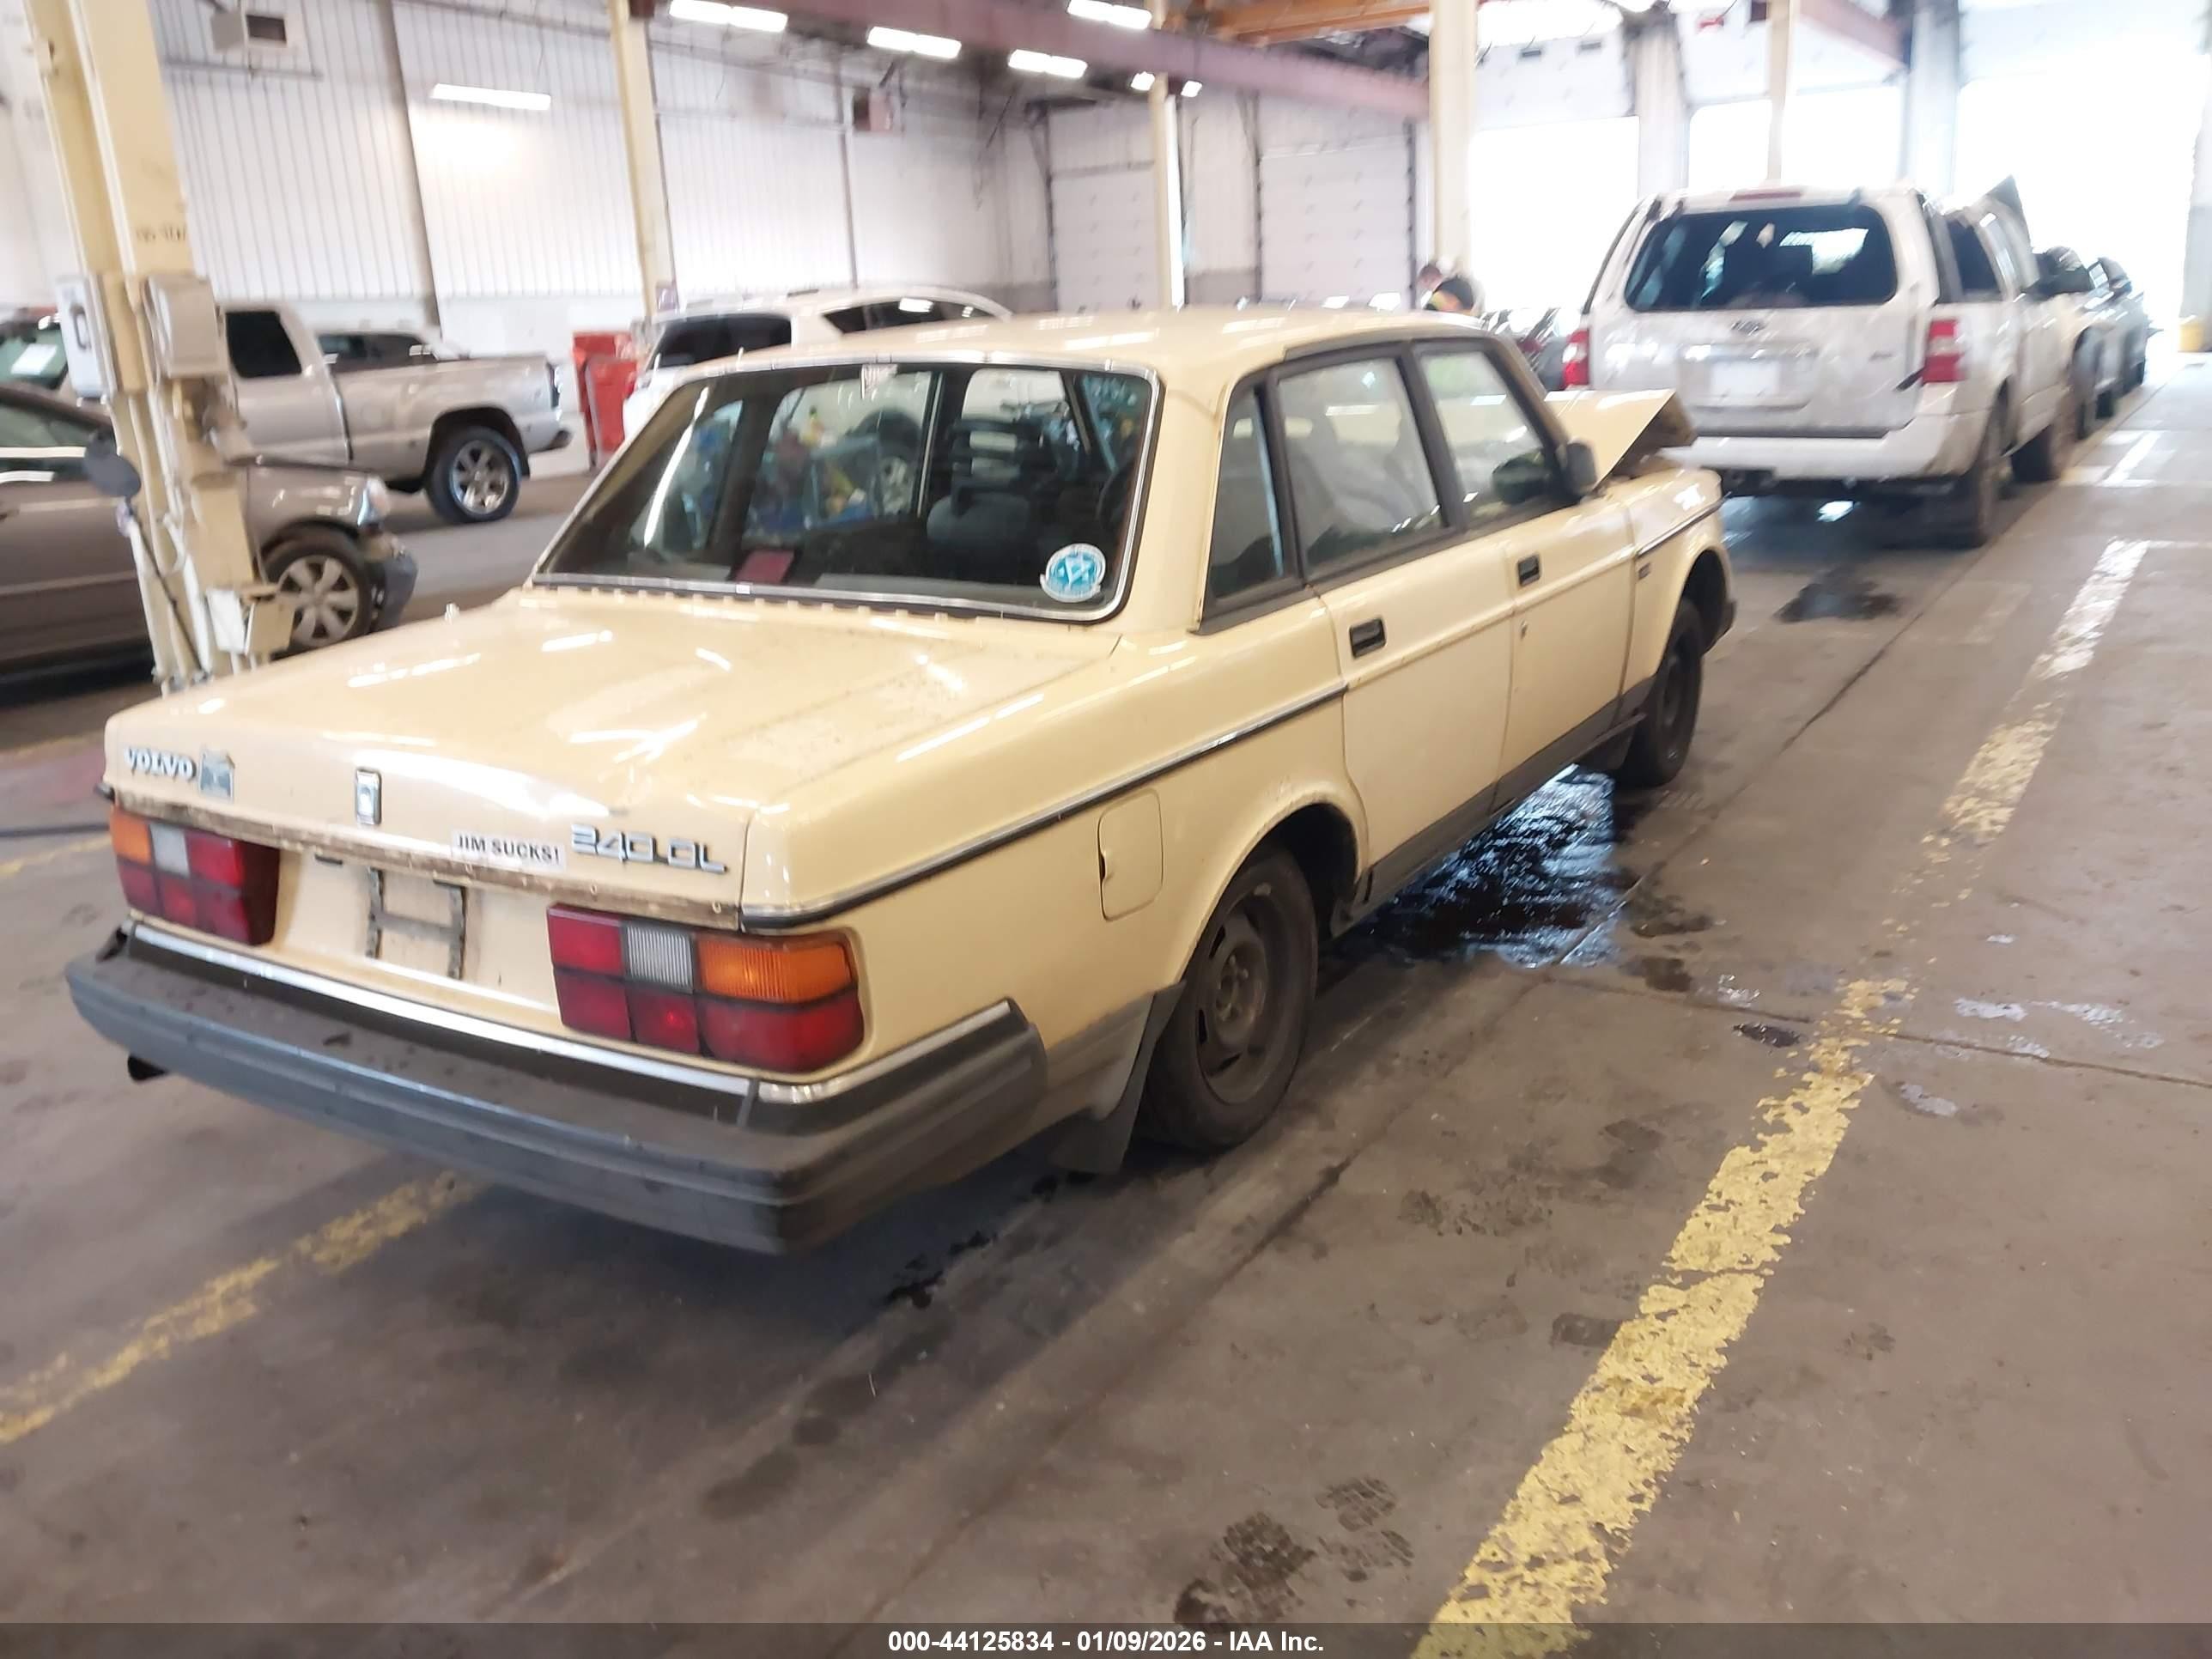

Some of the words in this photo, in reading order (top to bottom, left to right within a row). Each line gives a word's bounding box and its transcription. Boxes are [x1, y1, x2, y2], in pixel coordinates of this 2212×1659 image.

[123, 746, 196, 781] VOLVO
[458, 833, 486, 853] JIM
[491, 838, 560, 865] SUCKS!
